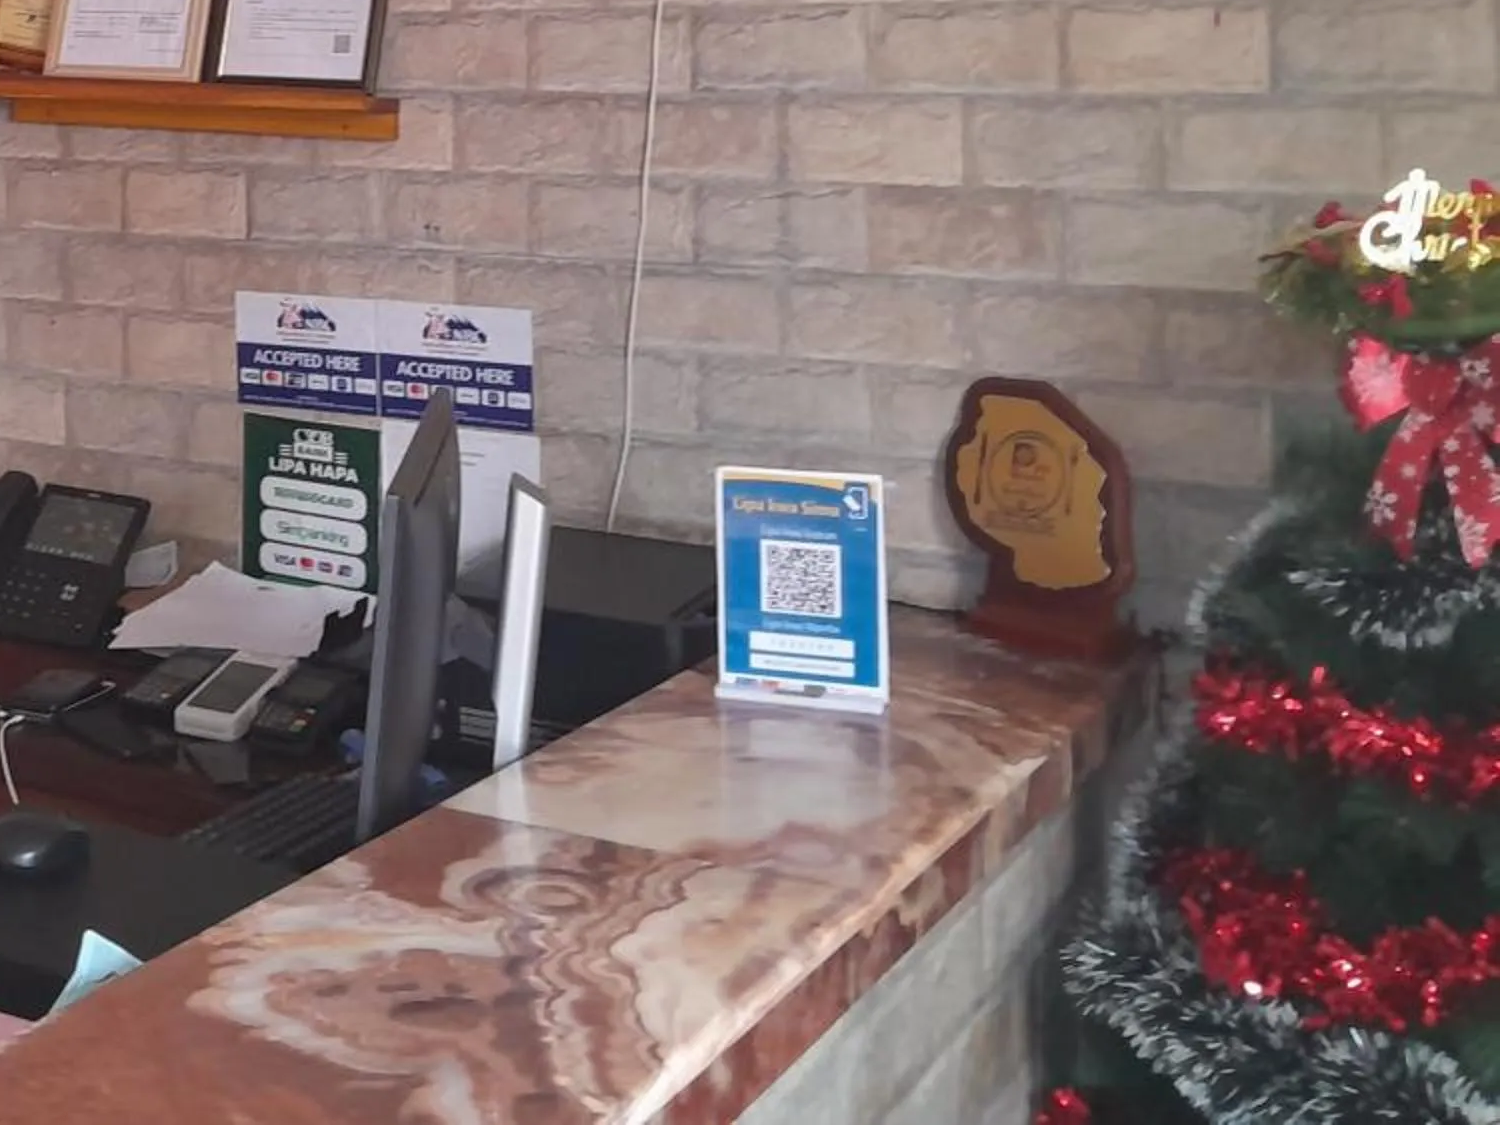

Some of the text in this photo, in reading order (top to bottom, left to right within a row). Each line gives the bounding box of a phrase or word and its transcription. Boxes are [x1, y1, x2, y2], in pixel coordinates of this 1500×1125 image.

[253, 348, 361, 372] ACCEPTED HERE
[396, 360, 515, 386] ACCEPTED HERE
[268, 456, 359, 483] LIPA HAPA
